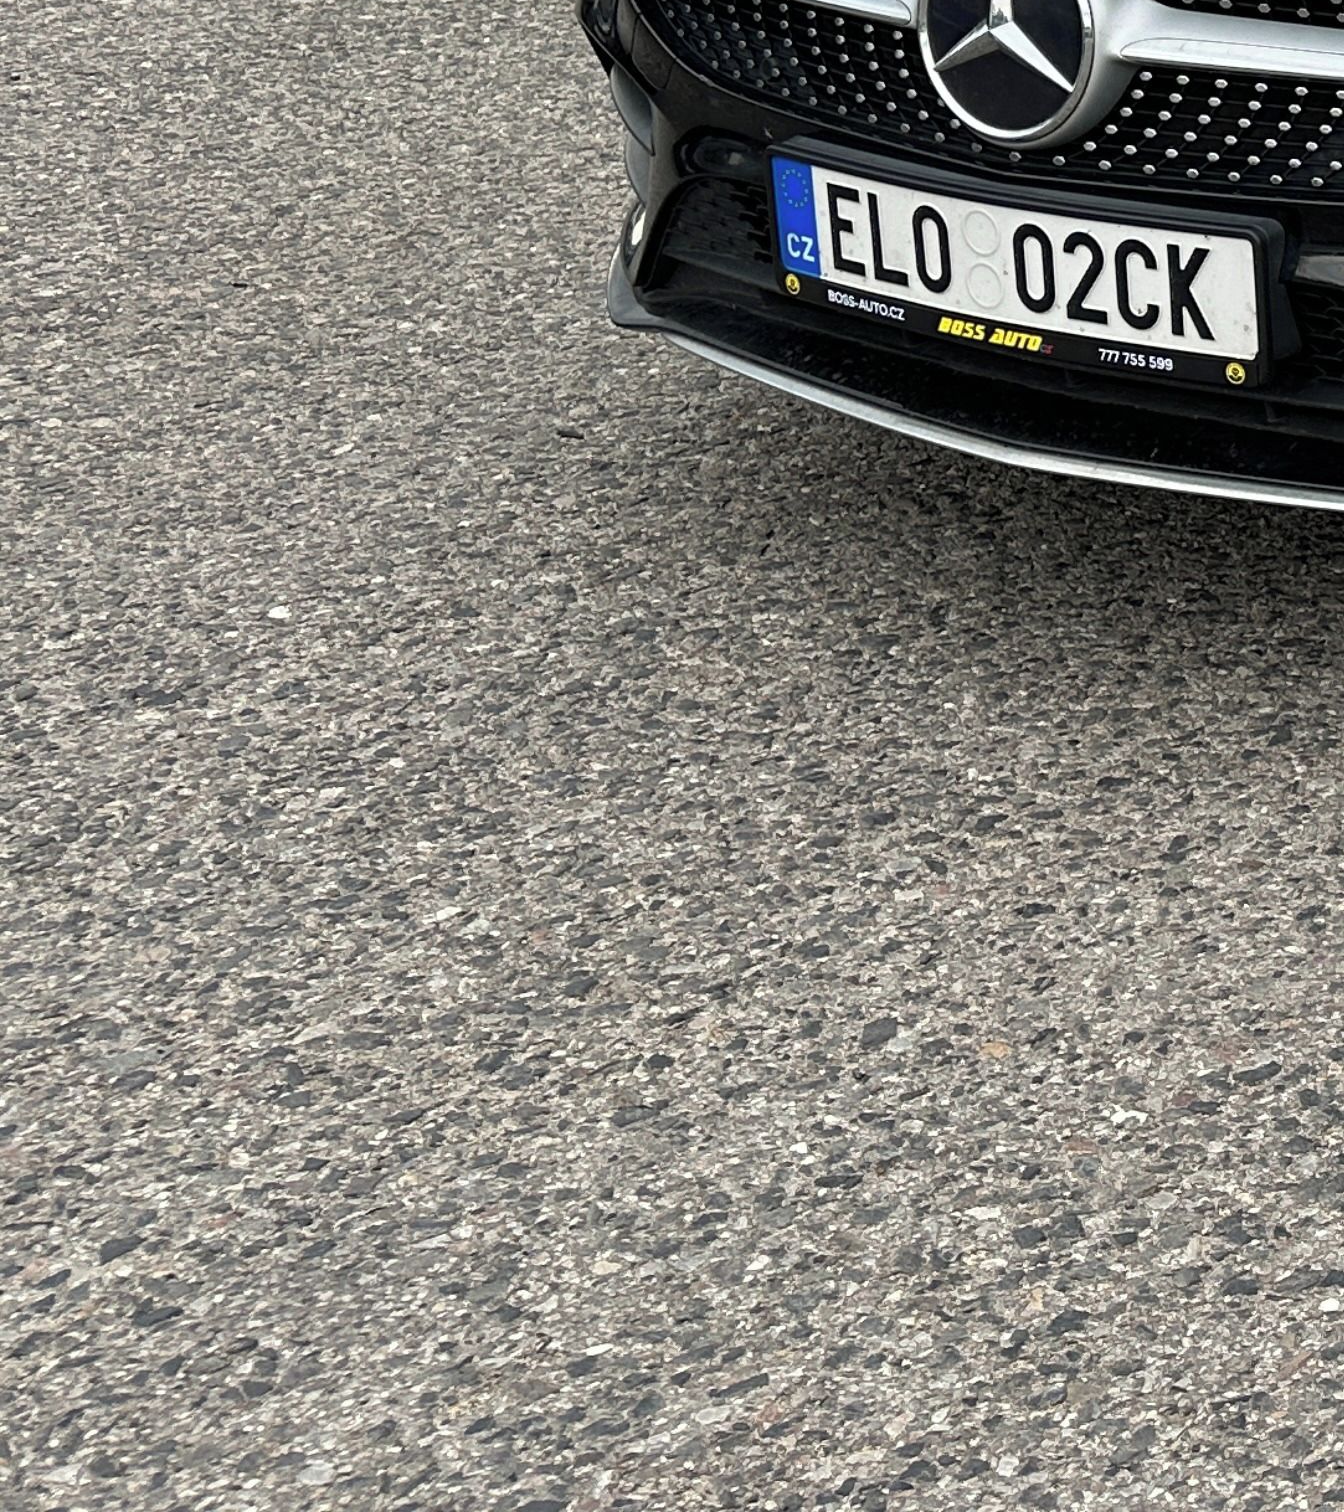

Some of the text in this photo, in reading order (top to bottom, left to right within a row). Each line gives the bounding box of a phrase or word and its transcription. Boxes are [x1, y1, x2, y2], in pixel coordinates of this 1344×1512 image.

[786, 232, 815, 263] CZ
[827, 289, 906, 321] BOSS-AUTO.CZ
[937, 316, 985, 341] BOSS
[988, 328, 1043, 353] AUTO
[1098, 347, 1174, 372] 777 755 599
